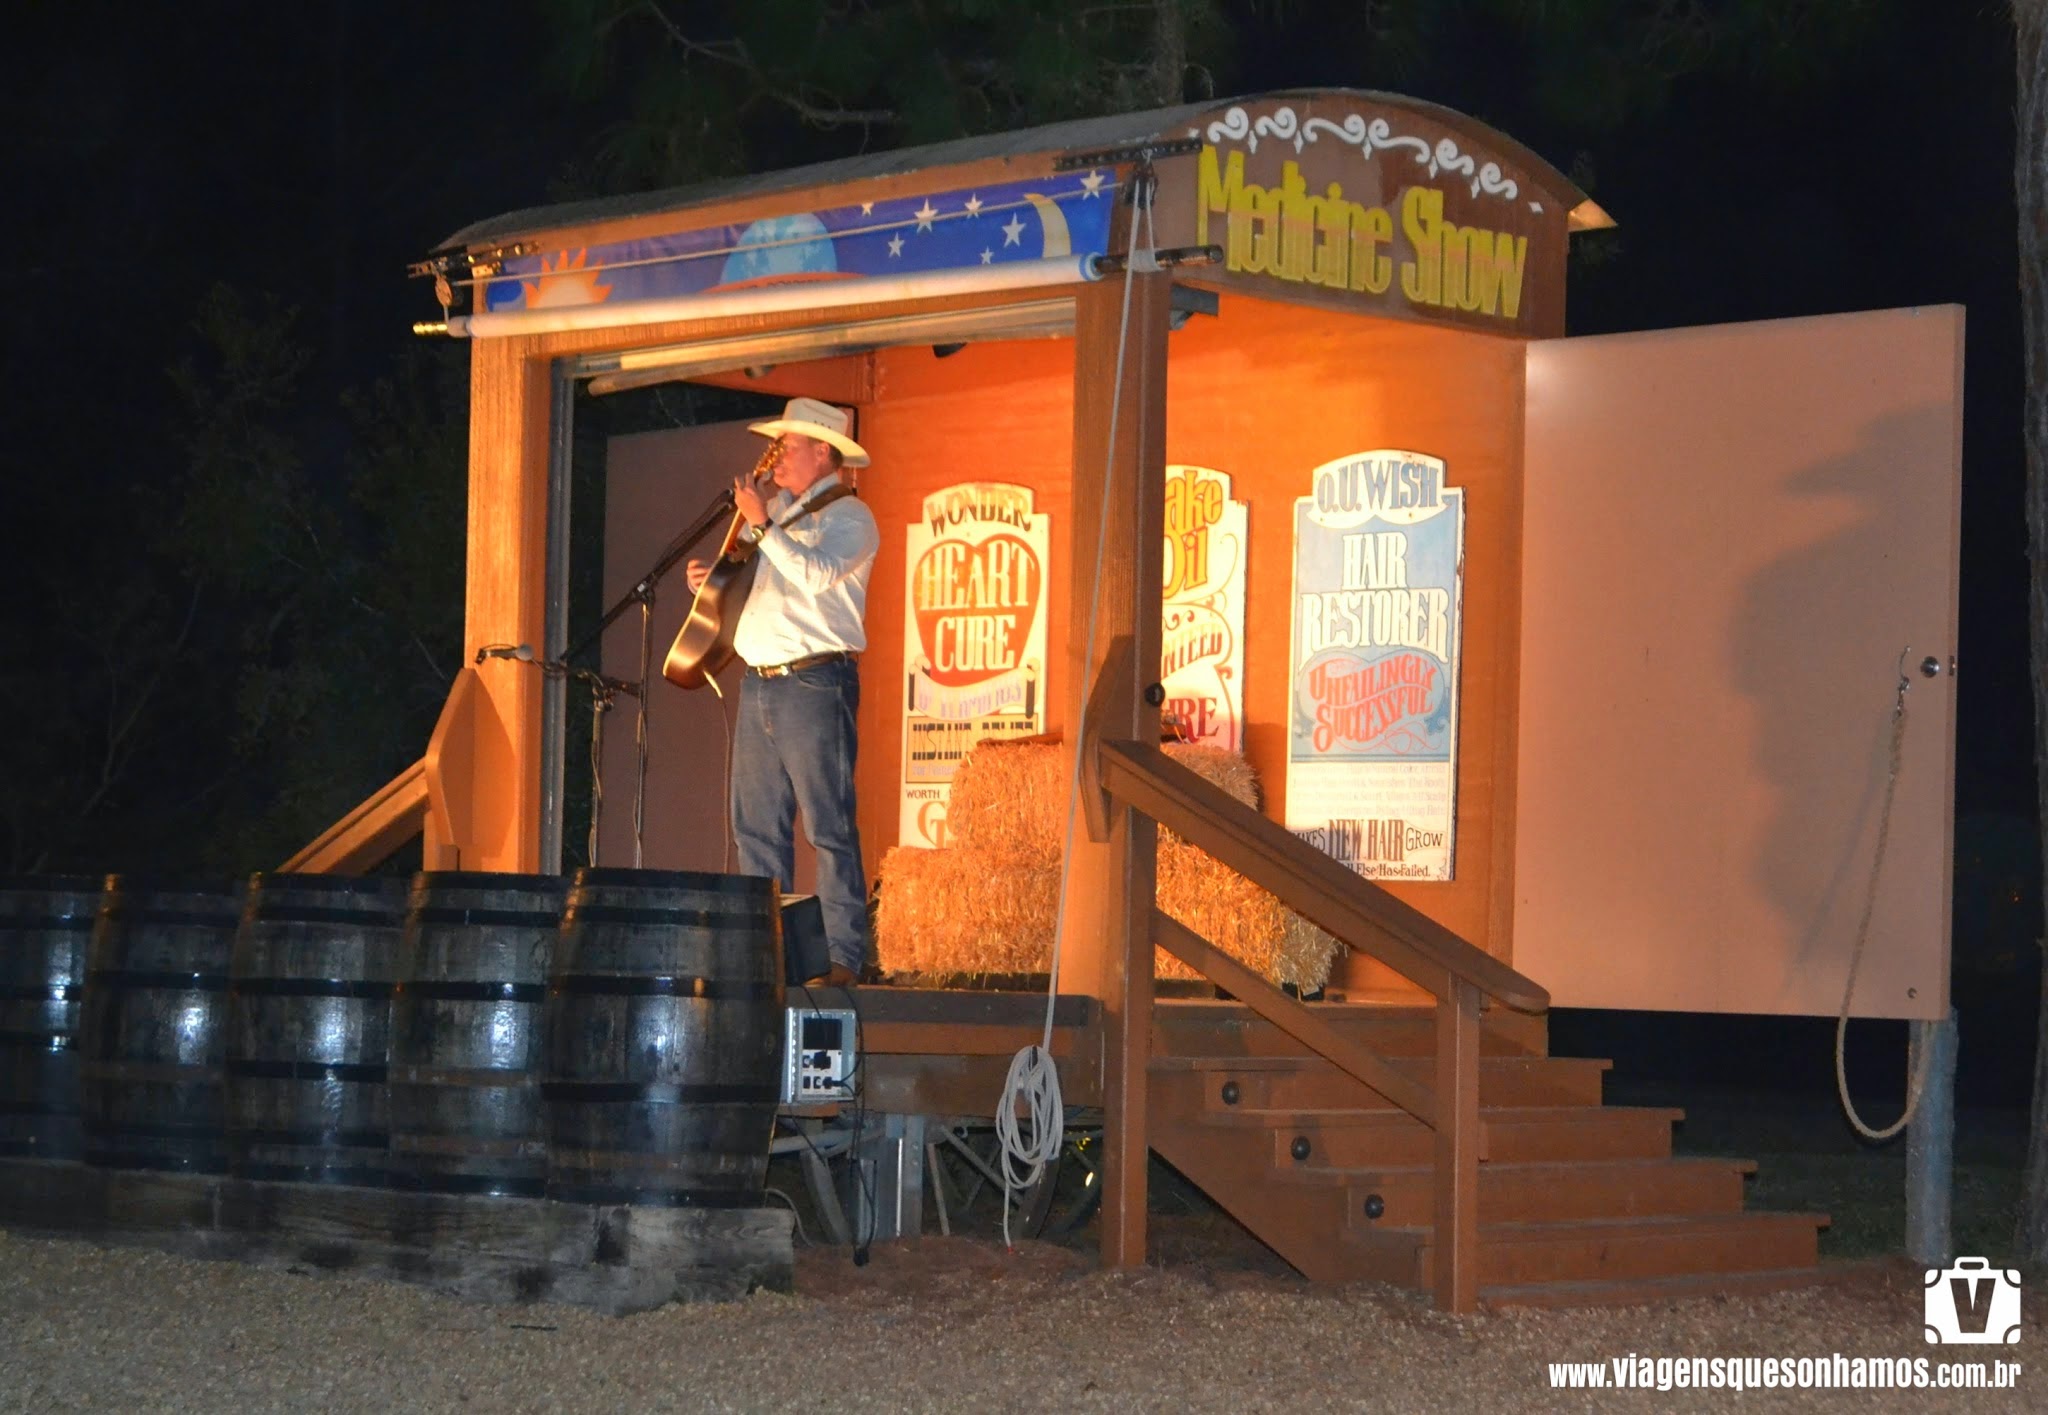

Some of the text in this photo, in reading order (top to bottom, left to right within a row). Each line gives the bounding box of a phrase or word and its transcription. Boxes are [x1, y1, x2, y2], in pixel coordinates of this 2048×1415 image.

[1196, 144, 1528, 319] Medicine Show
[926, 486, 1032, 538] WONDER
[1165, 469, 1223, 536] ake
[919, 539, 1036, 611] HEART
[1342, 531, 1408, 590] HAIR
[934, 614, 1017, 673] CURE
[1299, 587, 1450, 671] RESTORER
[1168, 697, 1219, 743] RE
[906, 789, 940, 799] WORTH
[1328, 819, 1365, 861] NEW
[1367, 818, 1405, 862] HAIR
[1405, 827, 1444, 851] GROW
